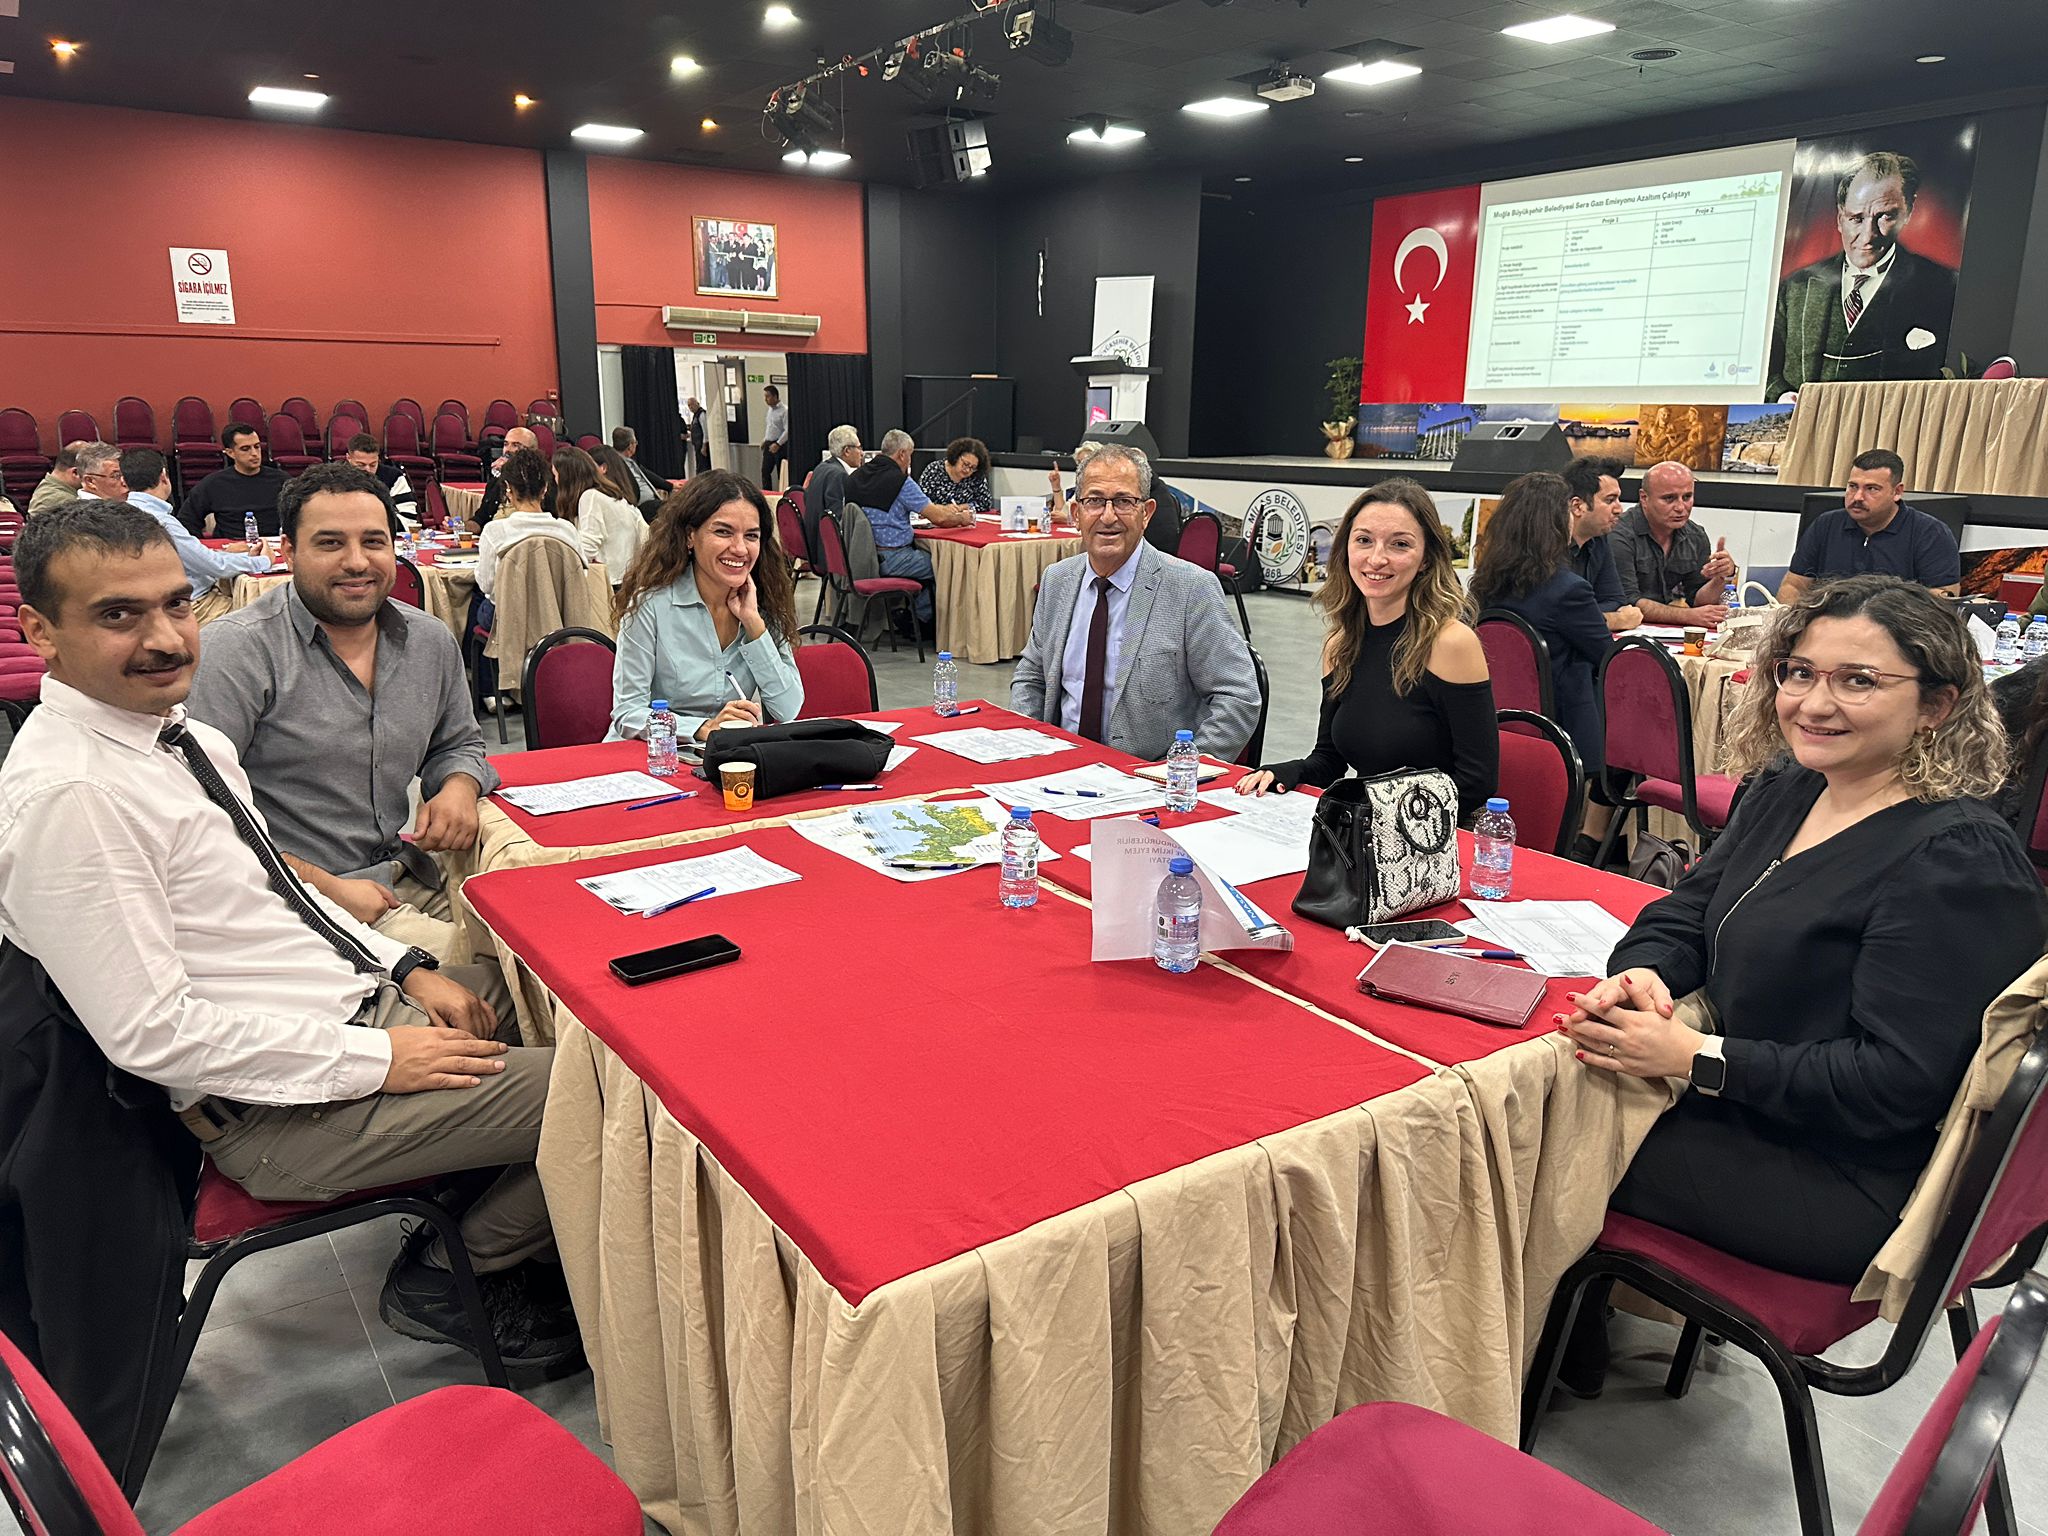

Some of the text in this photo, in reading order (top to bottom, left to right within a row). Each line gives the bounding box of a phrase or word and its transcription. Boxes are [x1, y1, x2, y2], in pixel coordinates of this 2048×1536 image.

[1493, 210, 1511, 219] Muğla
[1511, 206, 1544, 217] Büyükşehir
[1544, 203, 1575, 213] Belediyesi
[1575, 202, 1590, 210] Sera
[1605, 196, 1636, 207] Emisyonu
[1637, 193, 1661, 202] Azaltım
[1661, 190, 1691, 201] Çalıştayı
[1695, 207, 1709, 215] Proje
[178, 280, 228, 296] SİGARA İÇİLMEZ
[1264, 568, 1282, 579] 868
